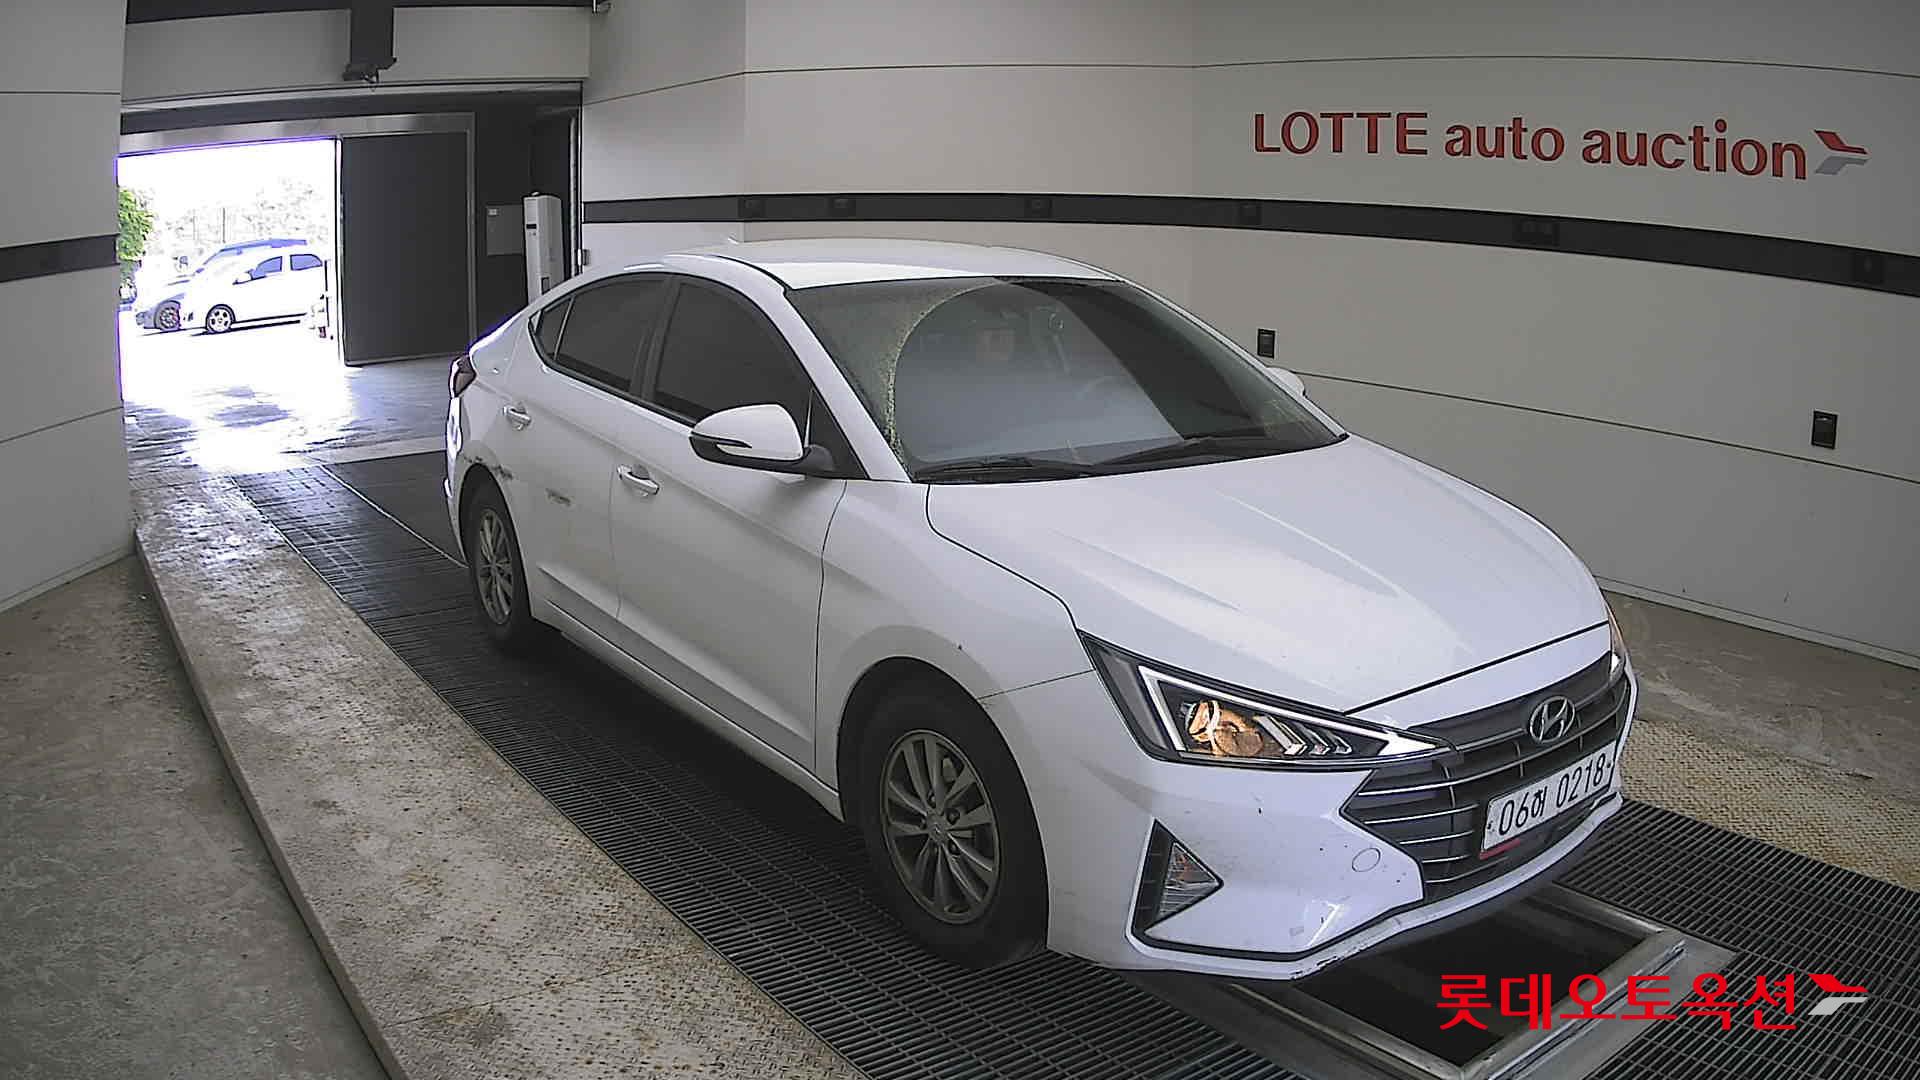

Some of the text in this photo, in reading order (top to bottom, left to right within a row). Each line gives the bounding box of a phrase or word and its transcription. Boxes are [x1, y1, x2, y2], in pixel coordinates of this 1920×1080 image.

[1253, 111, 1808, 181] LOTTE auto auction
[1498, 752, 1607, 836] 06허 0218
